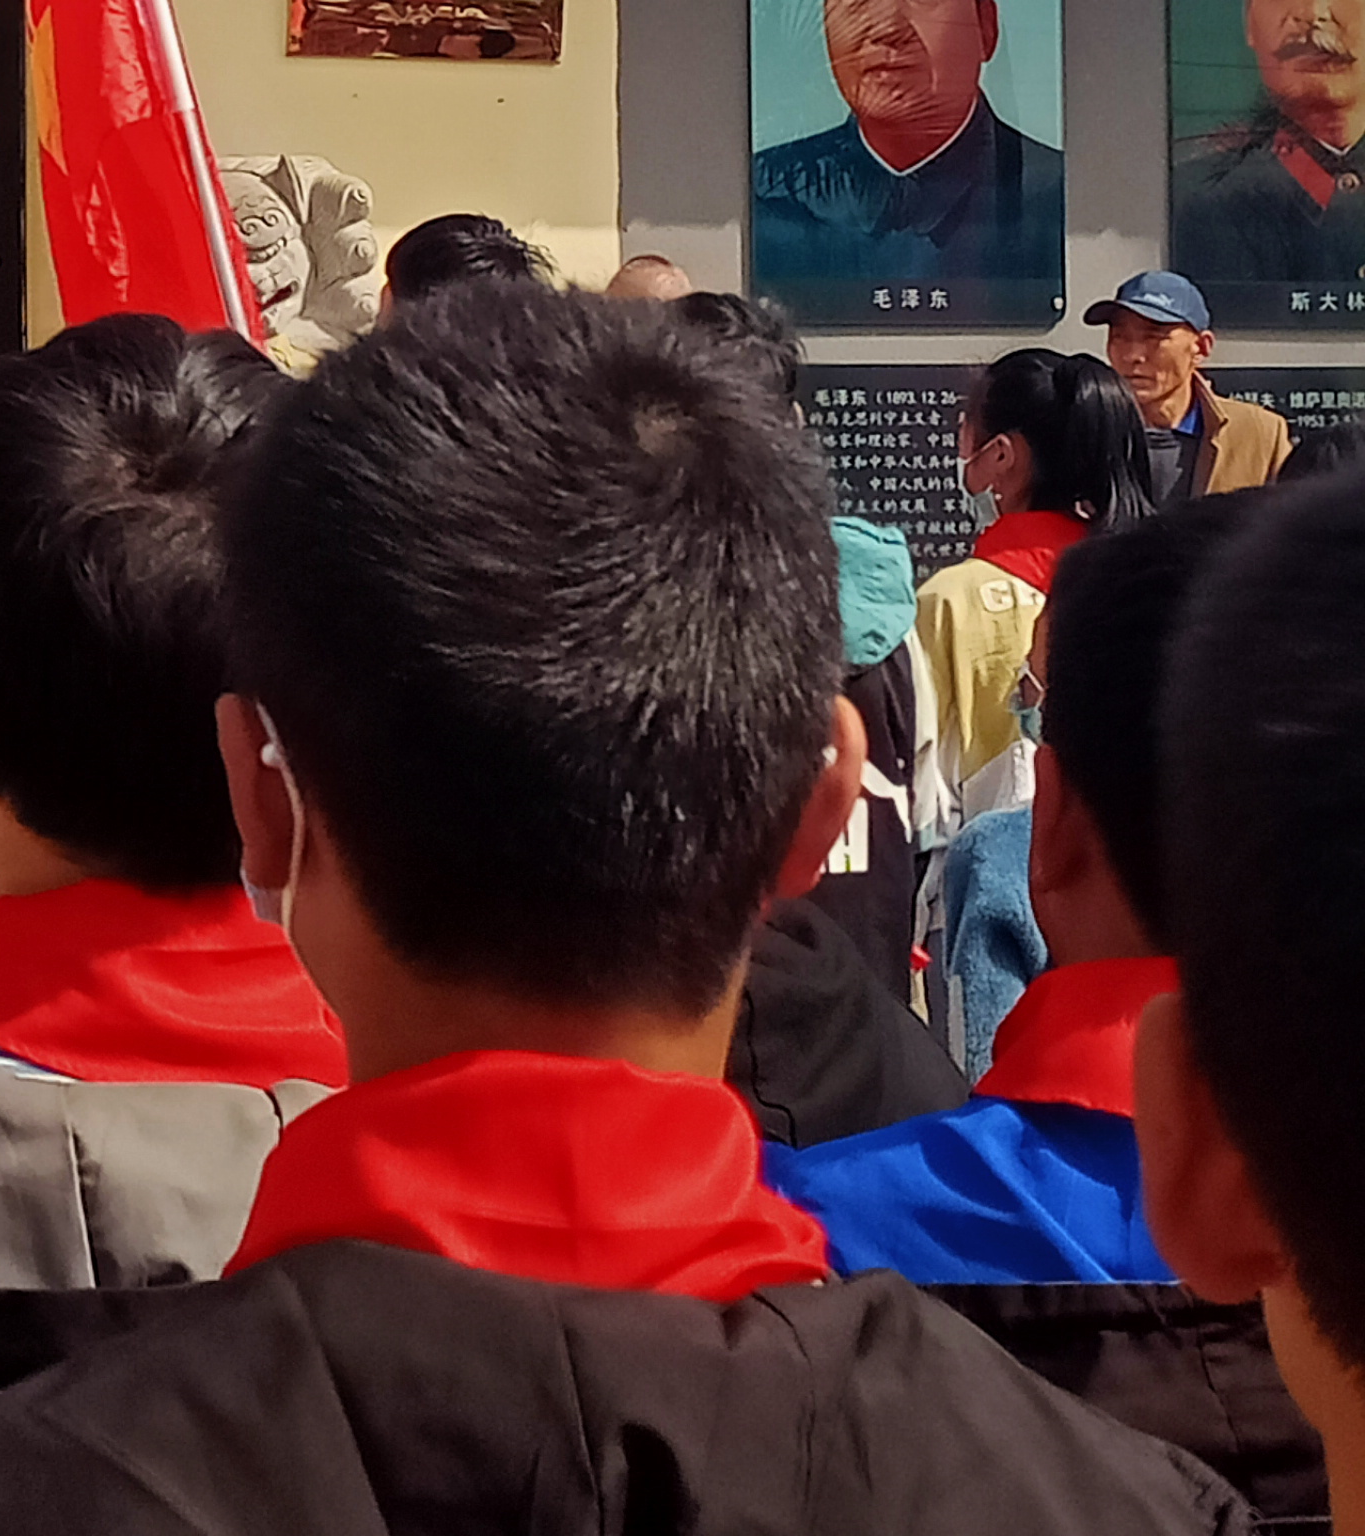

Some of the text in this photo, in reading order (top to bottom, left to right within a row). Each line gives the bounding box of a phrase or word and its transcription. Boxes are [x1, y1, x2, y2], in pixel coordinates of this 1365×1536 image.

[872, 288, 949, 309] 毛泽东
[1290, 291, 1365, 312] 斯大林
